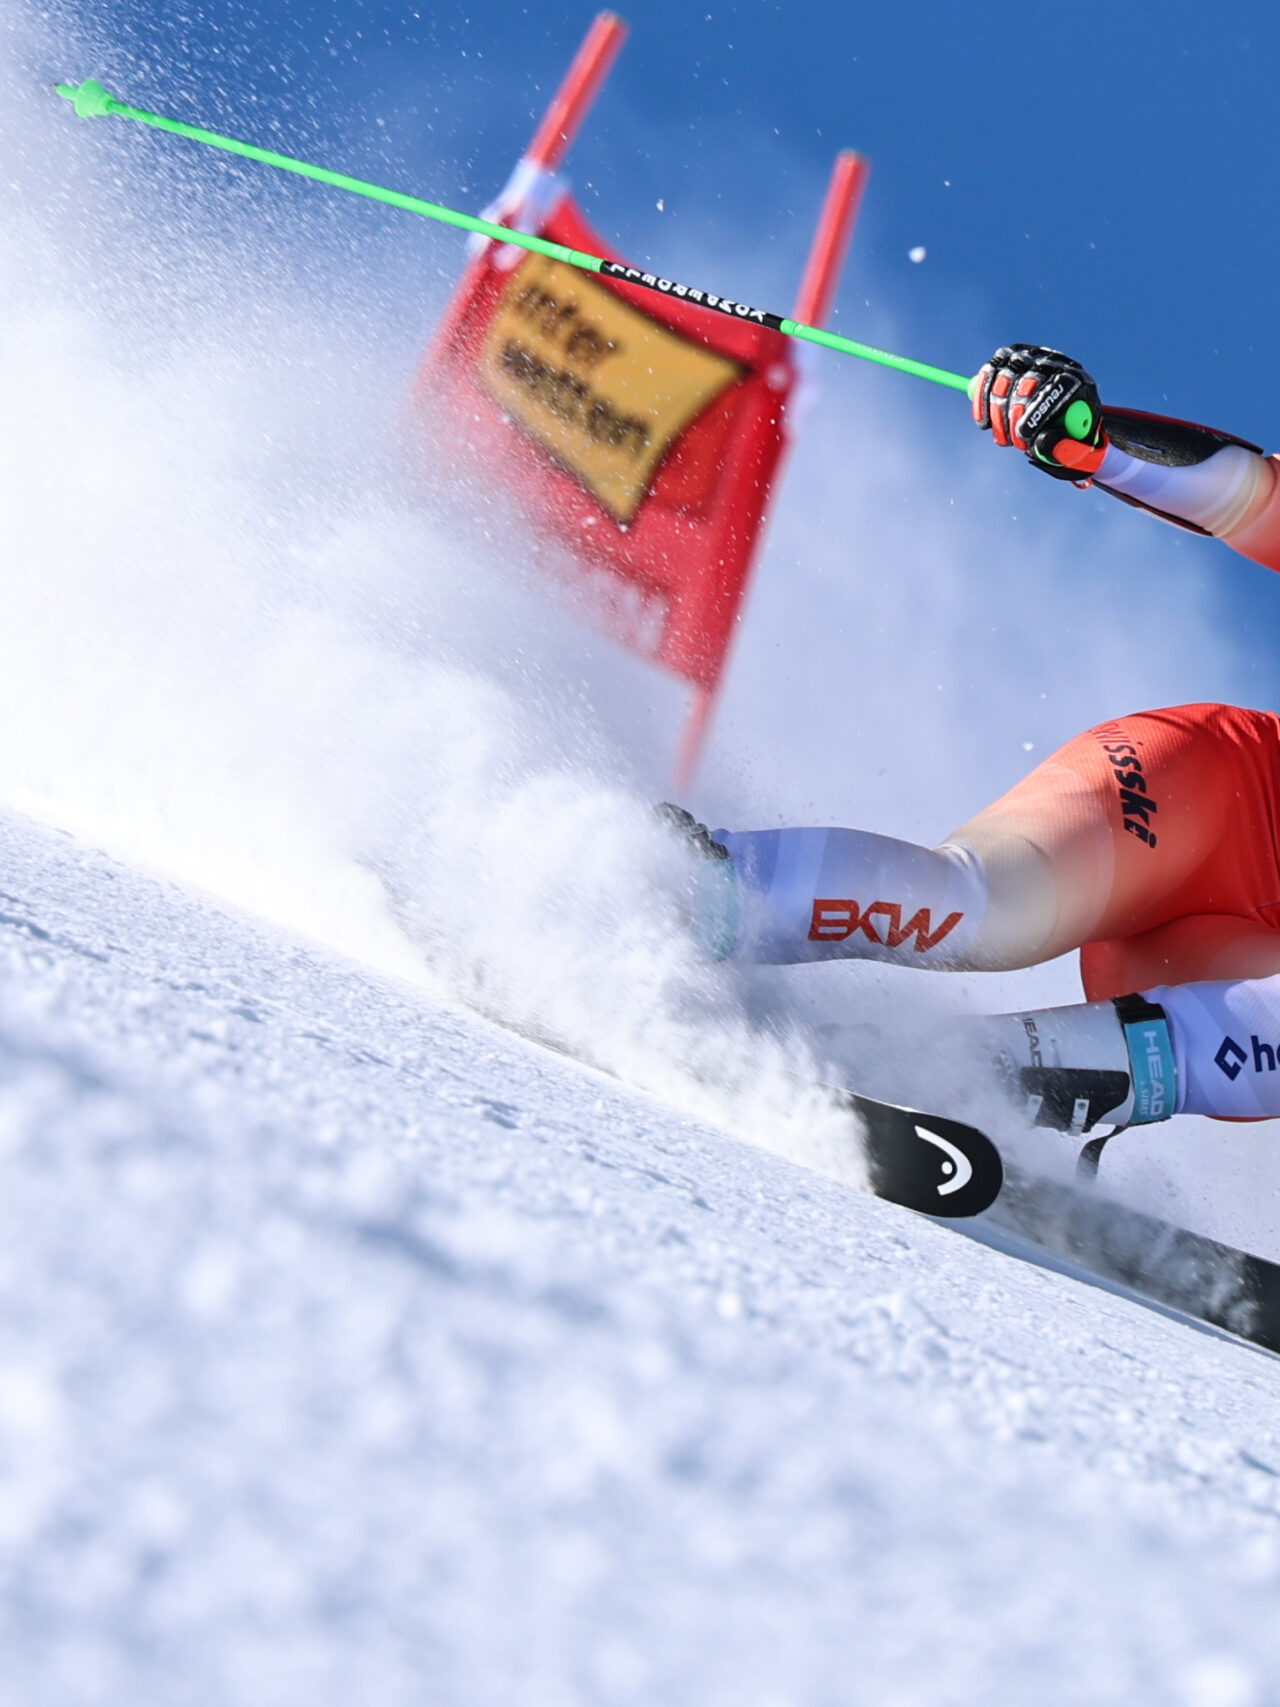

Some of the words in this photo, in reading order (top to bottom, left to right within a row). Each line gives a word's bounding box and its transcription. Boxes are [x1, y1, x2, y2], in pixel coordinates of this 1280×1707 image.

[1026, 384, 1065, 429] reusch
[808, 898, 964, 954] BKW
[1022, 1017, 1043, 1068] EAD
[1143, 1030, 1166, 1117] HEAD
